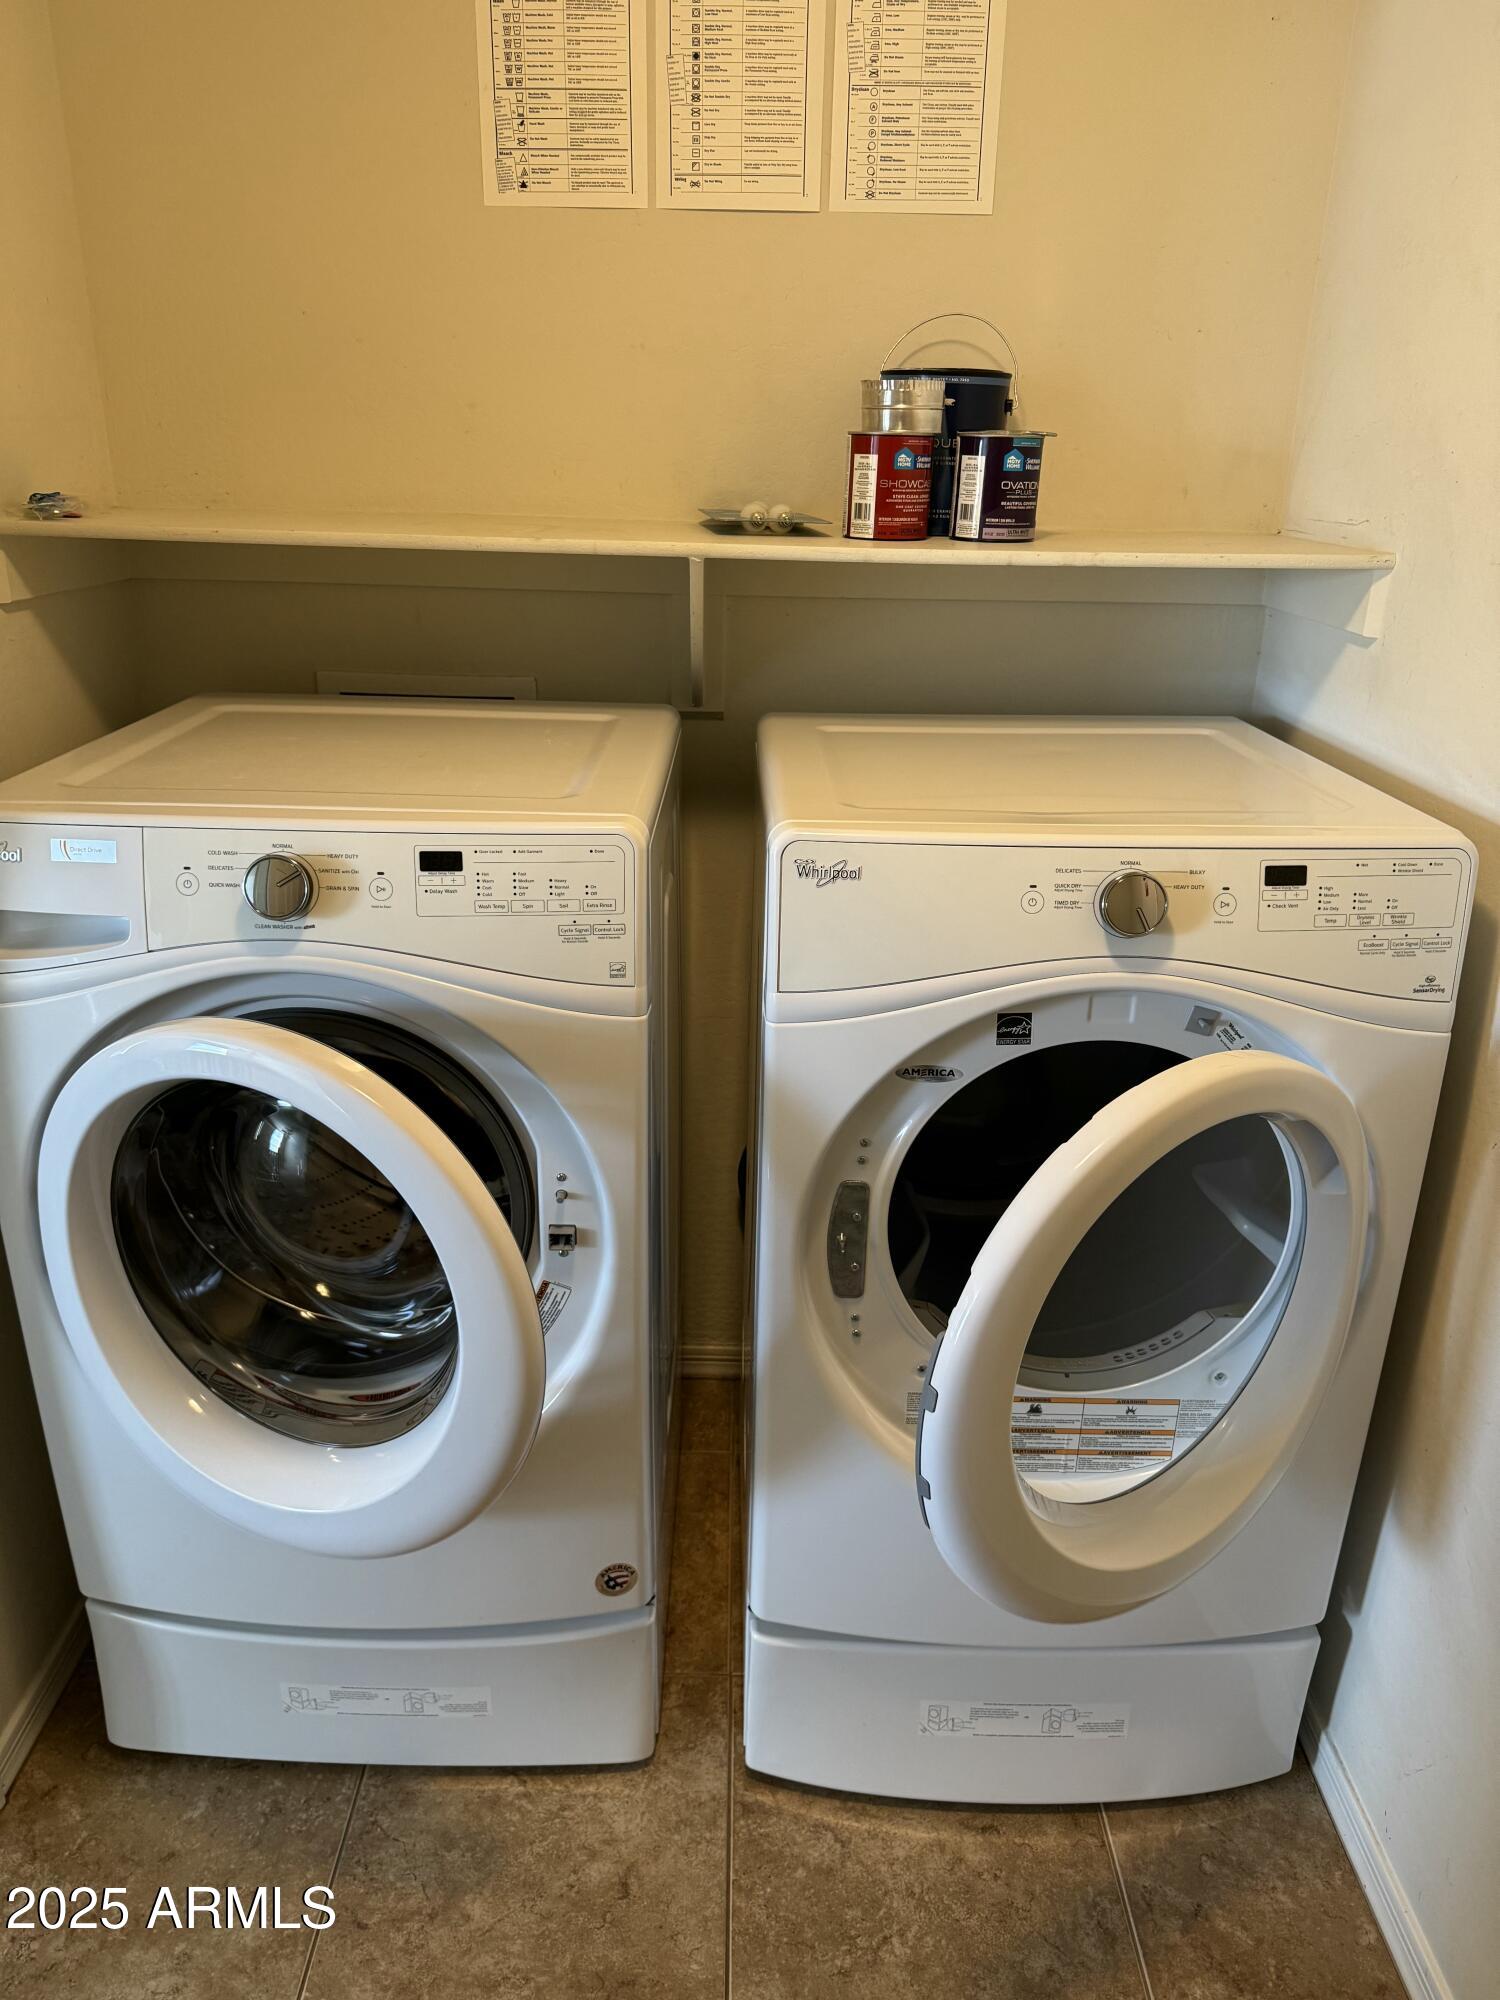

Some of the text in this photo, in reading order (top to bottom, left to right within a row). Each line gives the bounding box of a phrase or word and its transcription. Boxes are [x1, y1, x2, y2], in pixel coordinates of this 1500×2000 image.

[795, 860, 862, 884] Whirlpool
[902, 1068, 956, 1077] AMERICA
[600, 1564, 636, 1577] AMERICA
